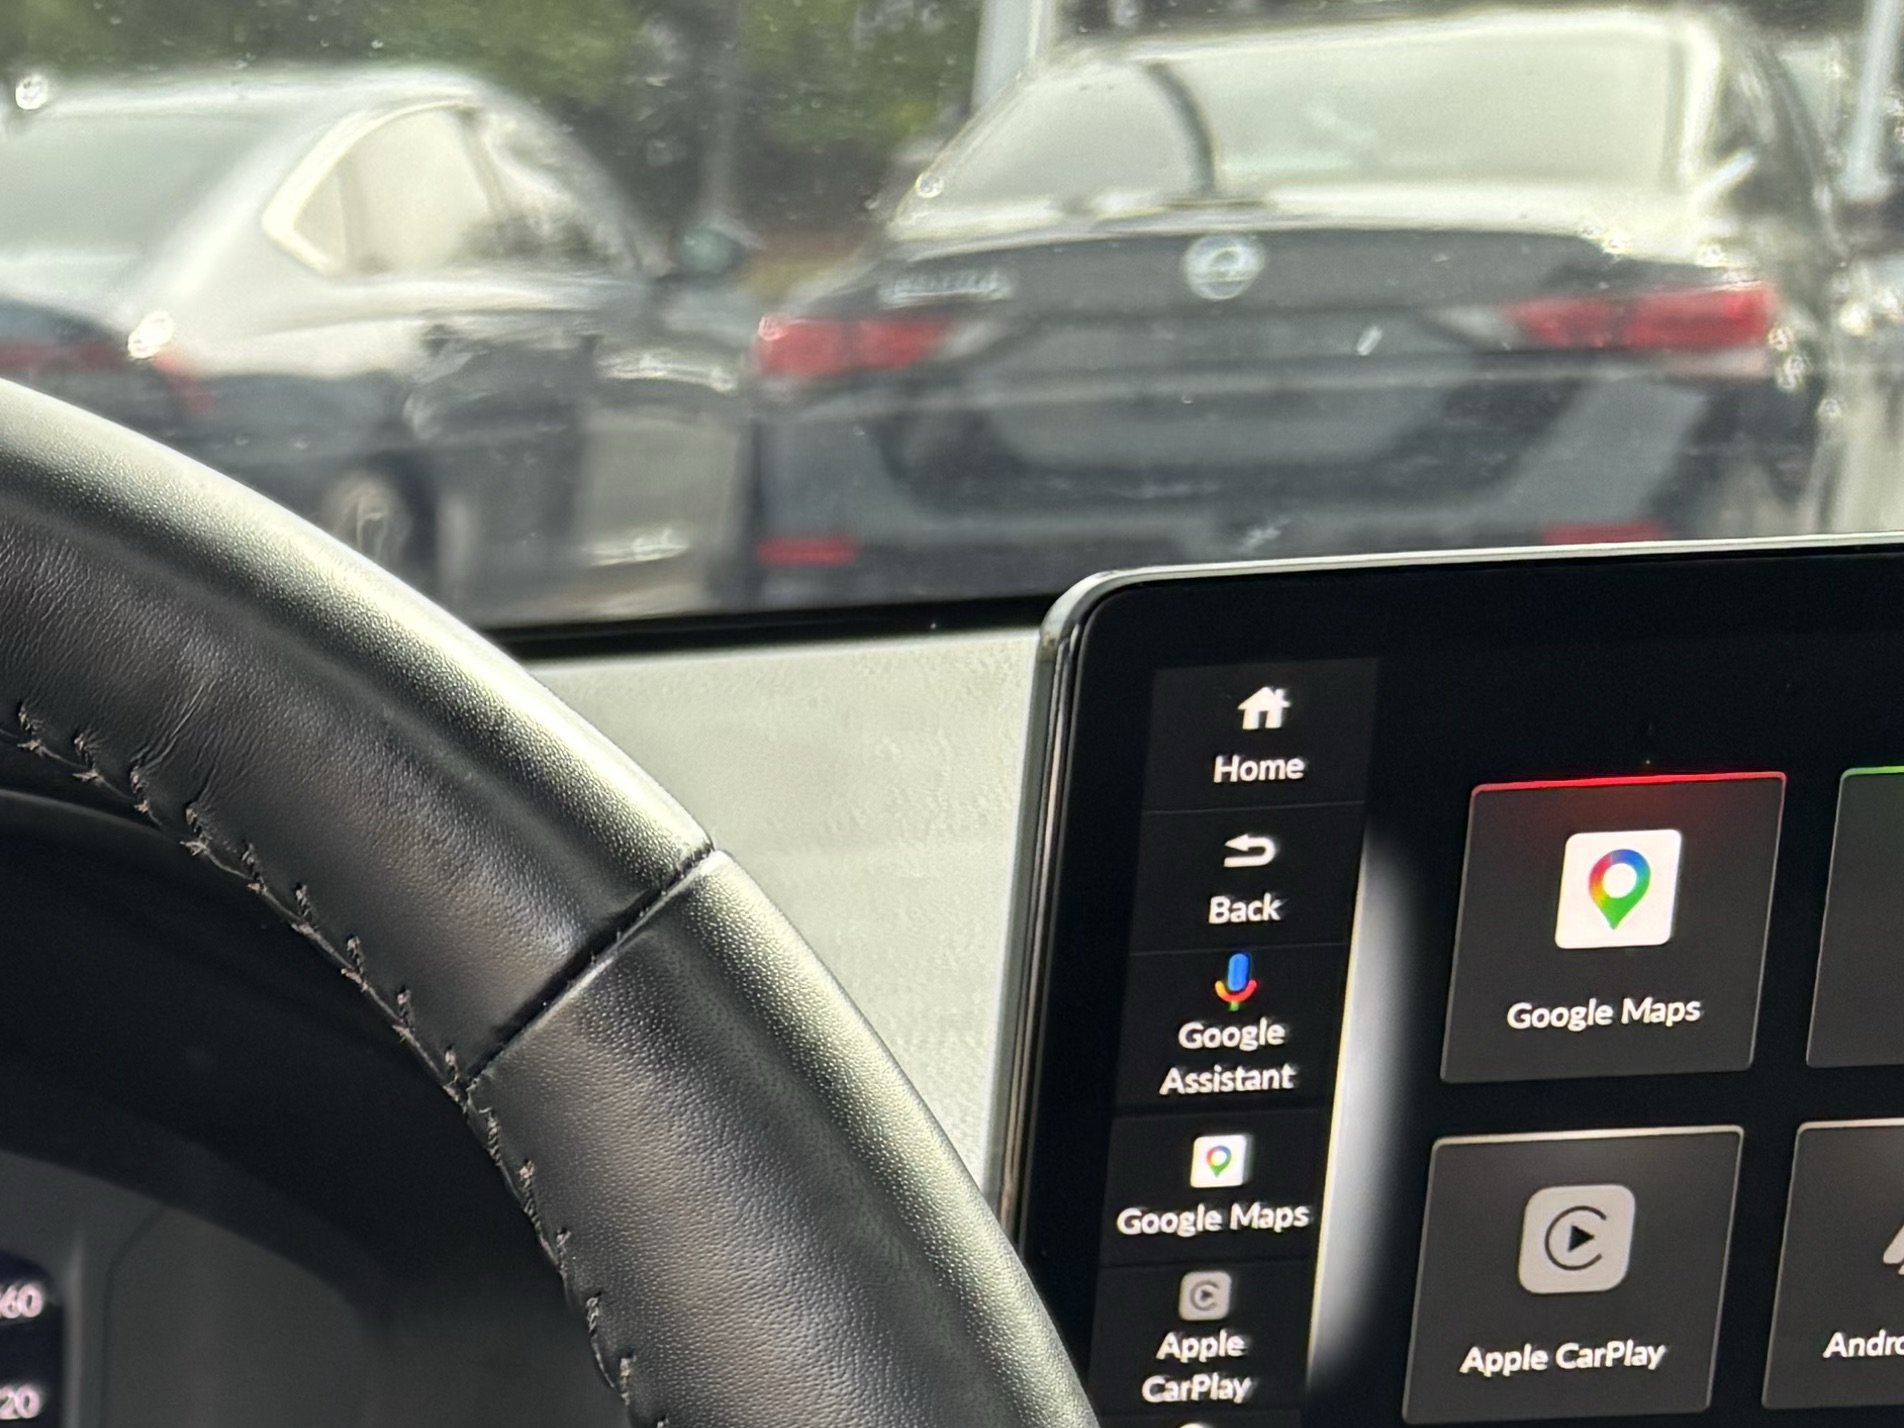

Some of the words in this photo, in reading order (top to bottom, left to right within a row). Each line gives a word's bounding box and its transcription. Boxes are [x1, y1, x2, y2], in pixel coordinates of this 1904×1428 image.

[1214, 754, 1305, 784] Home
[1209, 894, 1282, 924] Back
[1507, 1002, 1613, 1031] Google
[1622, 997, 1702, 1027] Maps
[1178, 1019, 1286, 1052] Google
[1159, 1062, 1298, 1096] Assistant
[1117, 1206, 1223, 1237] Google
[1230, 1203, 1310, 1234] Maps
[1156, 1332, 1246, 1365] Apple
[1459, 1344, 1548, 1377] Apple
[1555, 1340, 1667, 1371] CarPlay
[1141, 1374, 1253, 1406] CarPlay
